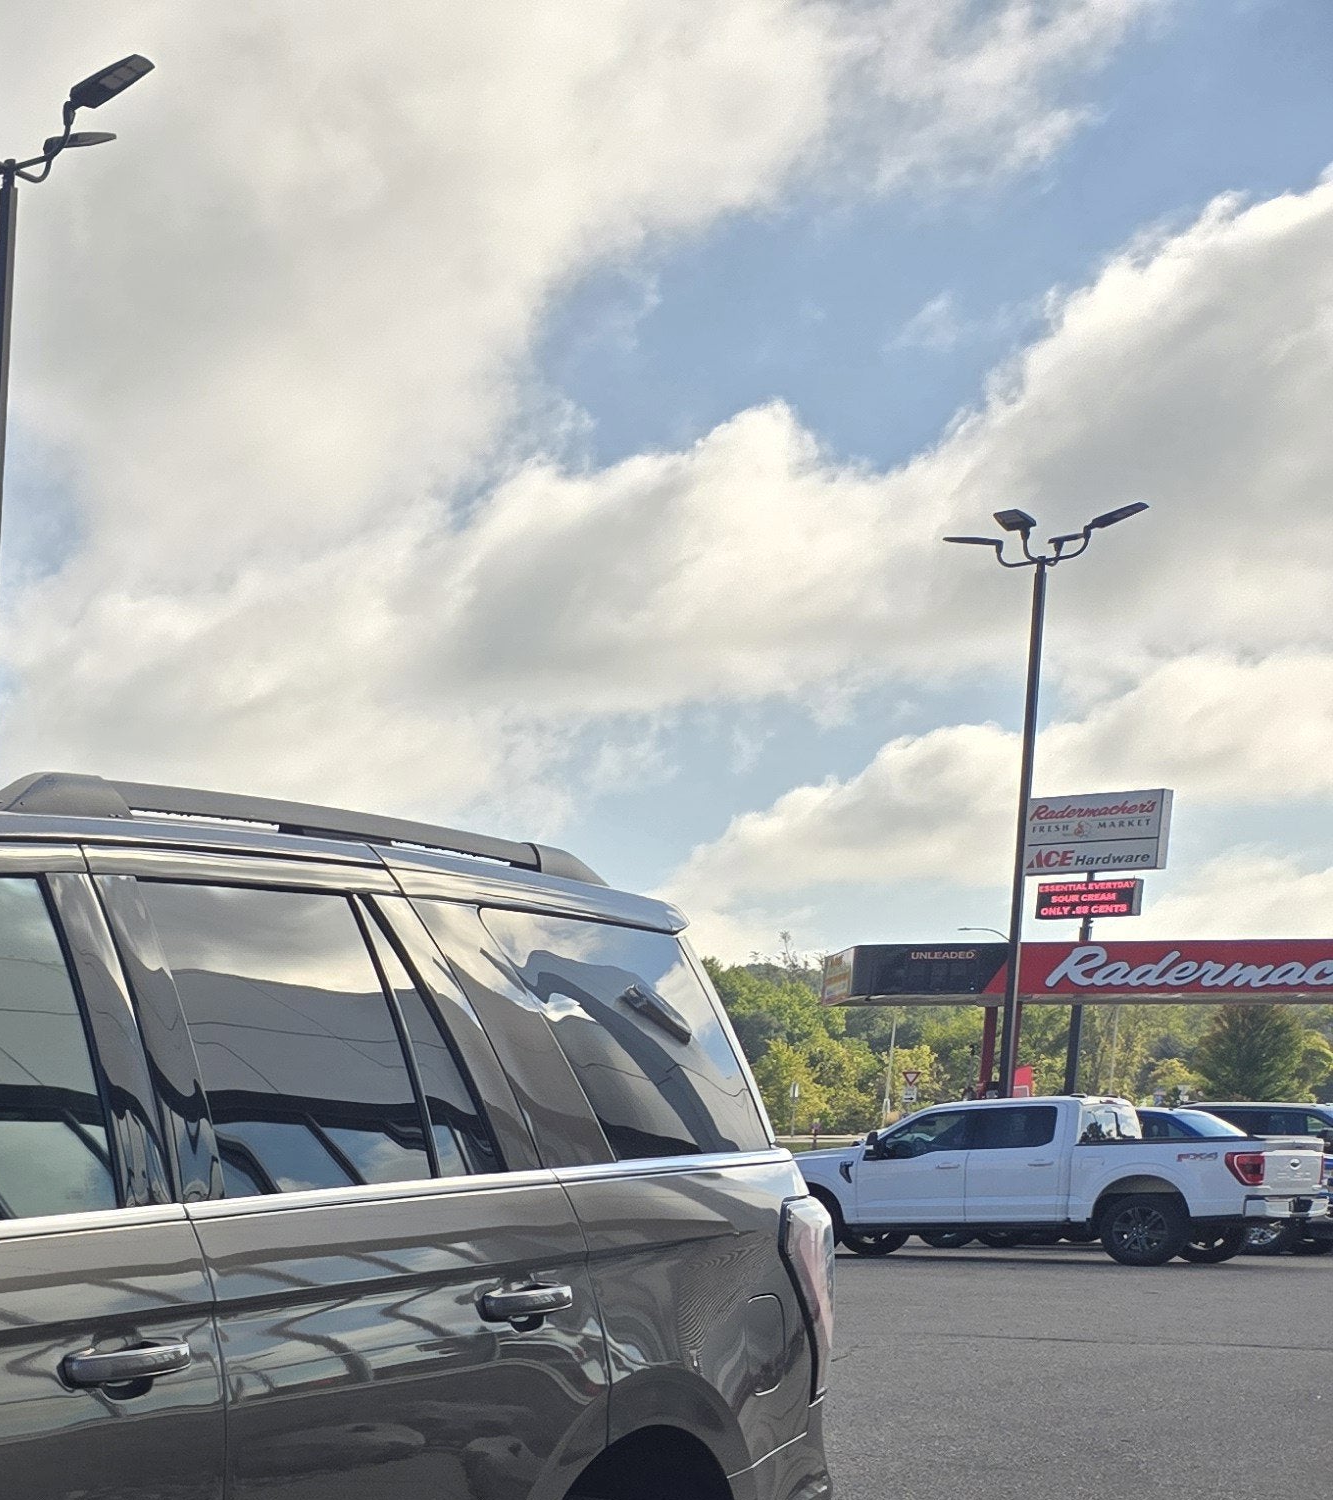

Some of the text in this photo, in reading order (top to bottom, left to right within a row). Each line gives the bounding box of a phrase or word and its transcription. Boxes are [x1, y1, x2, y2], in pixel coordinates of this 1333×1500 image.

[1030, 801, 1157, 821] Radermacher's
[1032, 818, 1151, 834] FRESH MARKET
[1026, 850, 1150, 869] ACE Hardware
[1038, 881, 1136, 892] ESSENTIAL EVERYDAY
[1051, 893, 1117, 903] SOUR CREAM
[1040, 906, 1071, 916] ONLY
[1091, 903, 1128, 913] CENTS
[911, 950, 976, 960] UNLEADED
